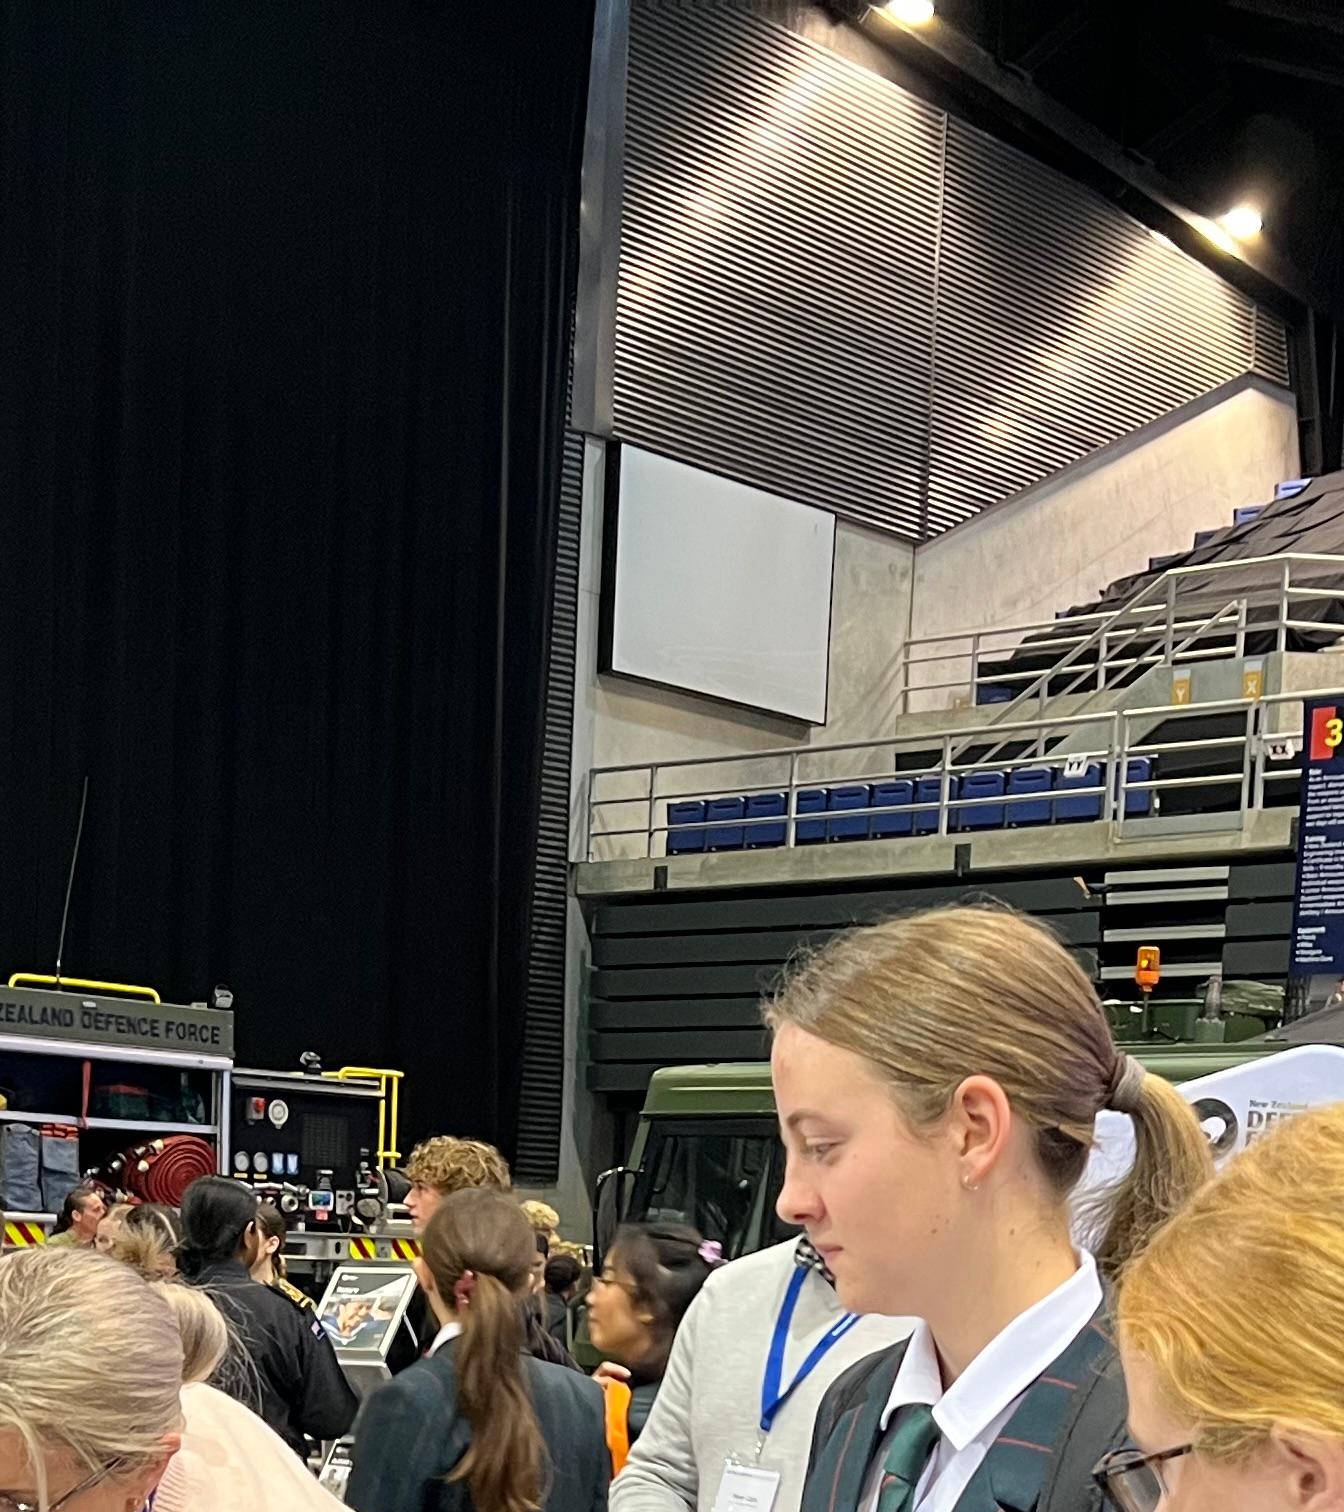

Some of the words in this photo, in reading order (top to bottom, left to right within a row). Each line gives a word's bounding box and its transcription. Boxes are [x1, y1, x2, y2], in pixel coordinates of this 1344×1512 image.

[1324, 718, 1344, 747] 3
[81, 1010, 160, 1037] DEFENCE
[165, 1021, 221, 1044] FORCE
